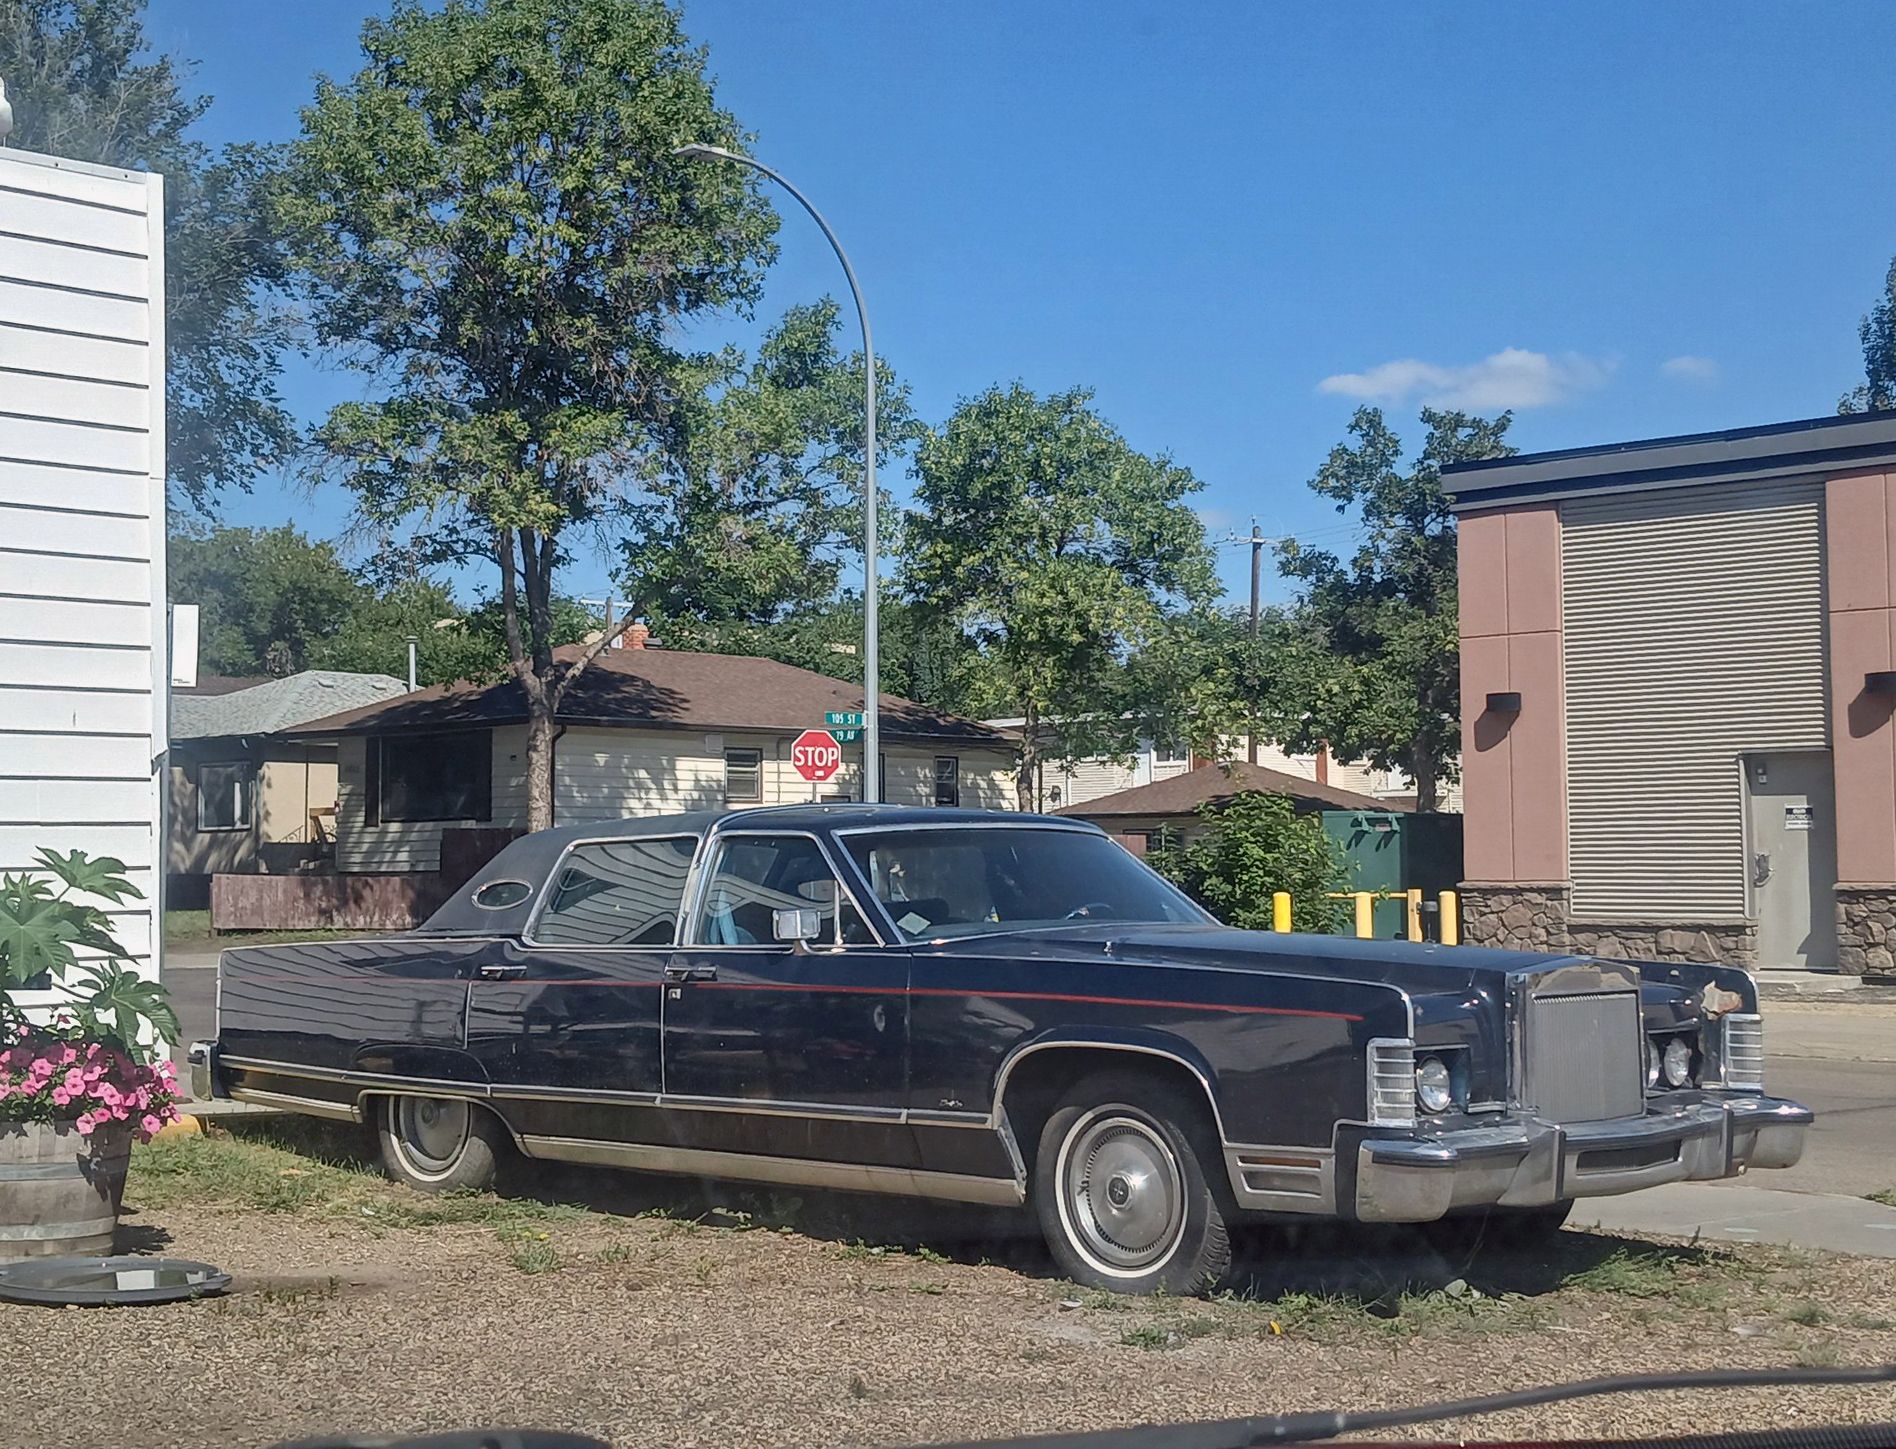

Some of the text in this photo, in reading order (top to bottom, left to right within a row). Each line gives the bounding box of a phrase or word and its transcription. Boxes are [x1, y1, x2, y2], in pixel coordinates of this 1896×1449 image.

[832, 713, 856, 724] 105 ST
[794, 746, 838, 767] STOP
